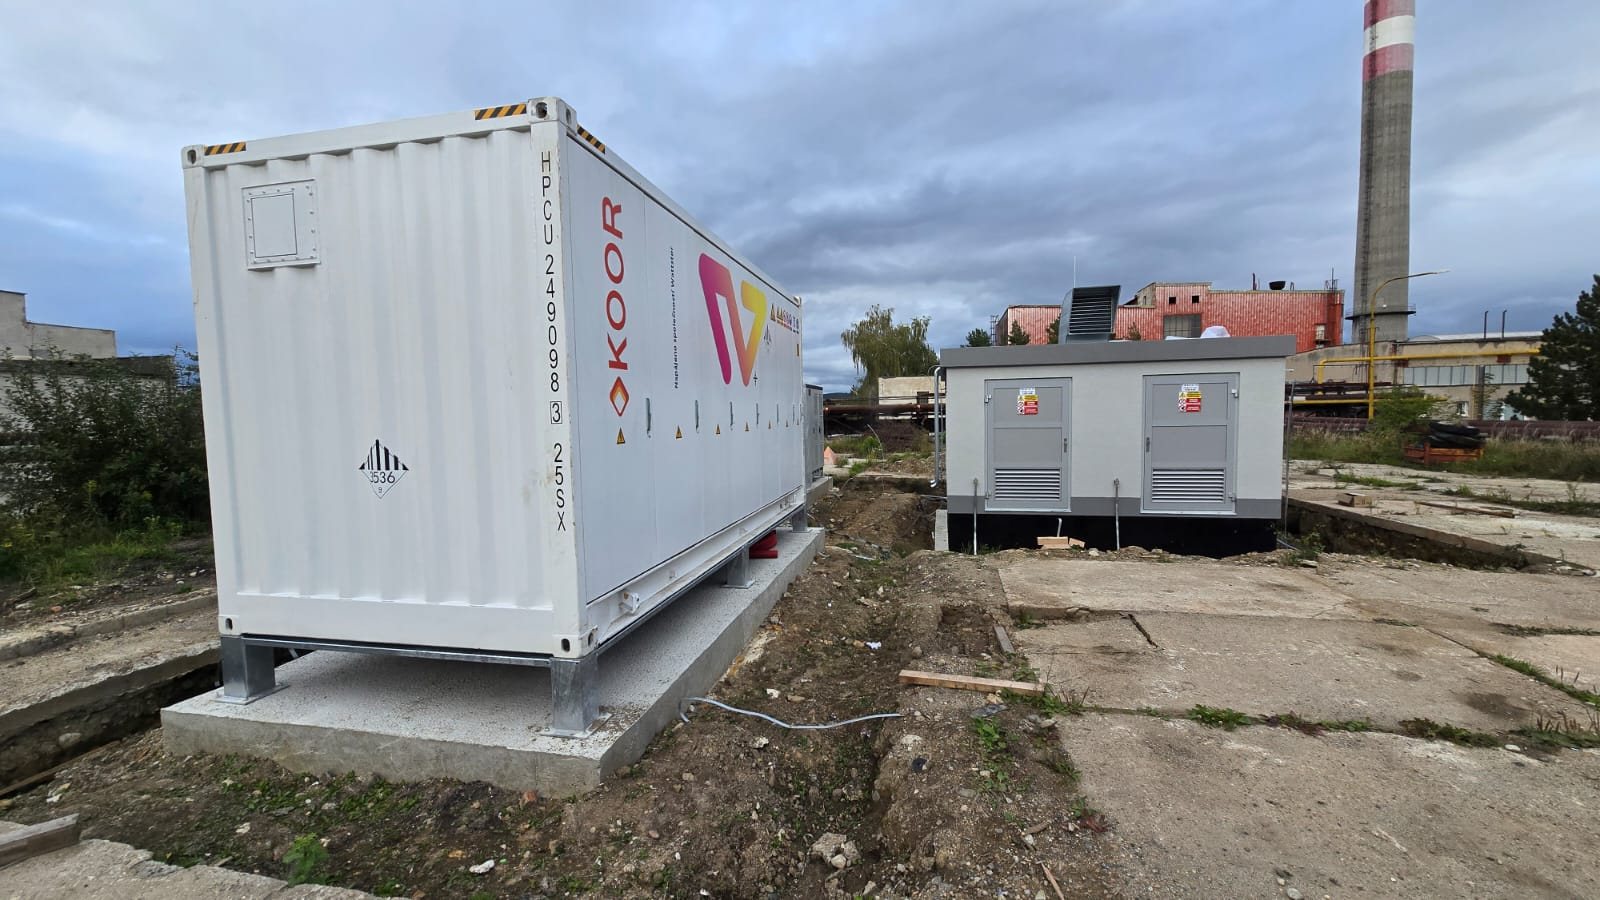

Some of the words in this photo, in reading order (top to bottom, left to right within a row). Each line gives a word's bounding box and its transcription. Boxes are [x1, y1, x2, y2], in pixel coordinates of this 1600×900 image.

[541, 151, 554, 245] HPCU
[545, 254, 560, 393] 249098
[602, 196, 628, 371] KOOR
[552, 402, 561, 423] 3
[553, 442, 566, 532] 25SX
